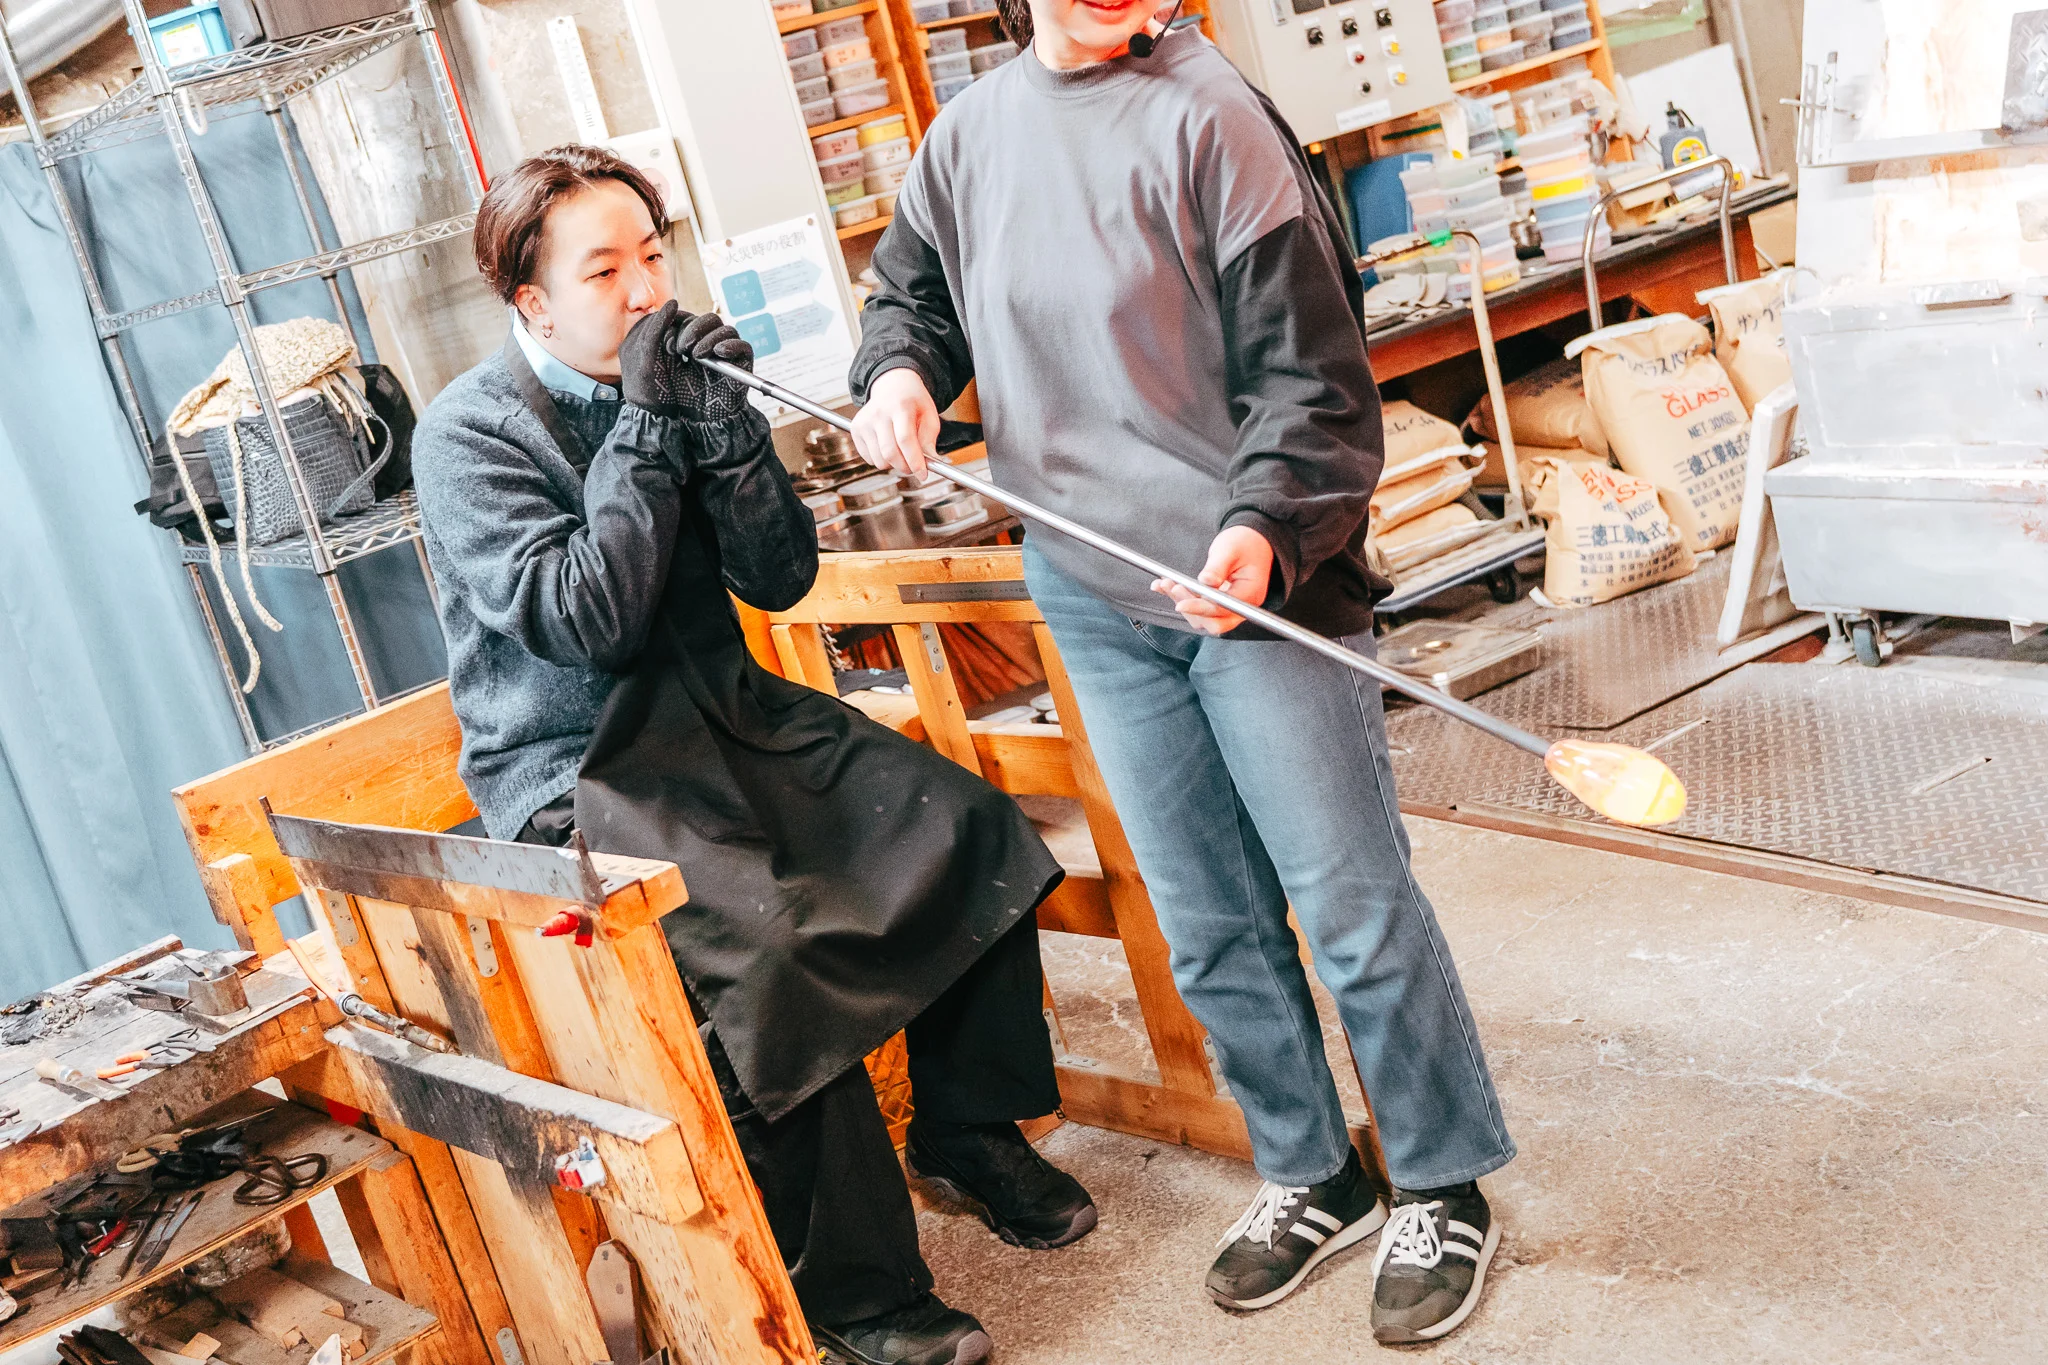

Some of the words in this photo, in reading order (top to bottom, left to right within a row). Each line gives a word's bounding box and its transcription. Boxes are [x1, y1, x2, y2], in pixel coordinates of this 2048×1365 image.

[725, 230, 807, 267] 火災時の役割
[1686, 421, 1708, 440] NET
